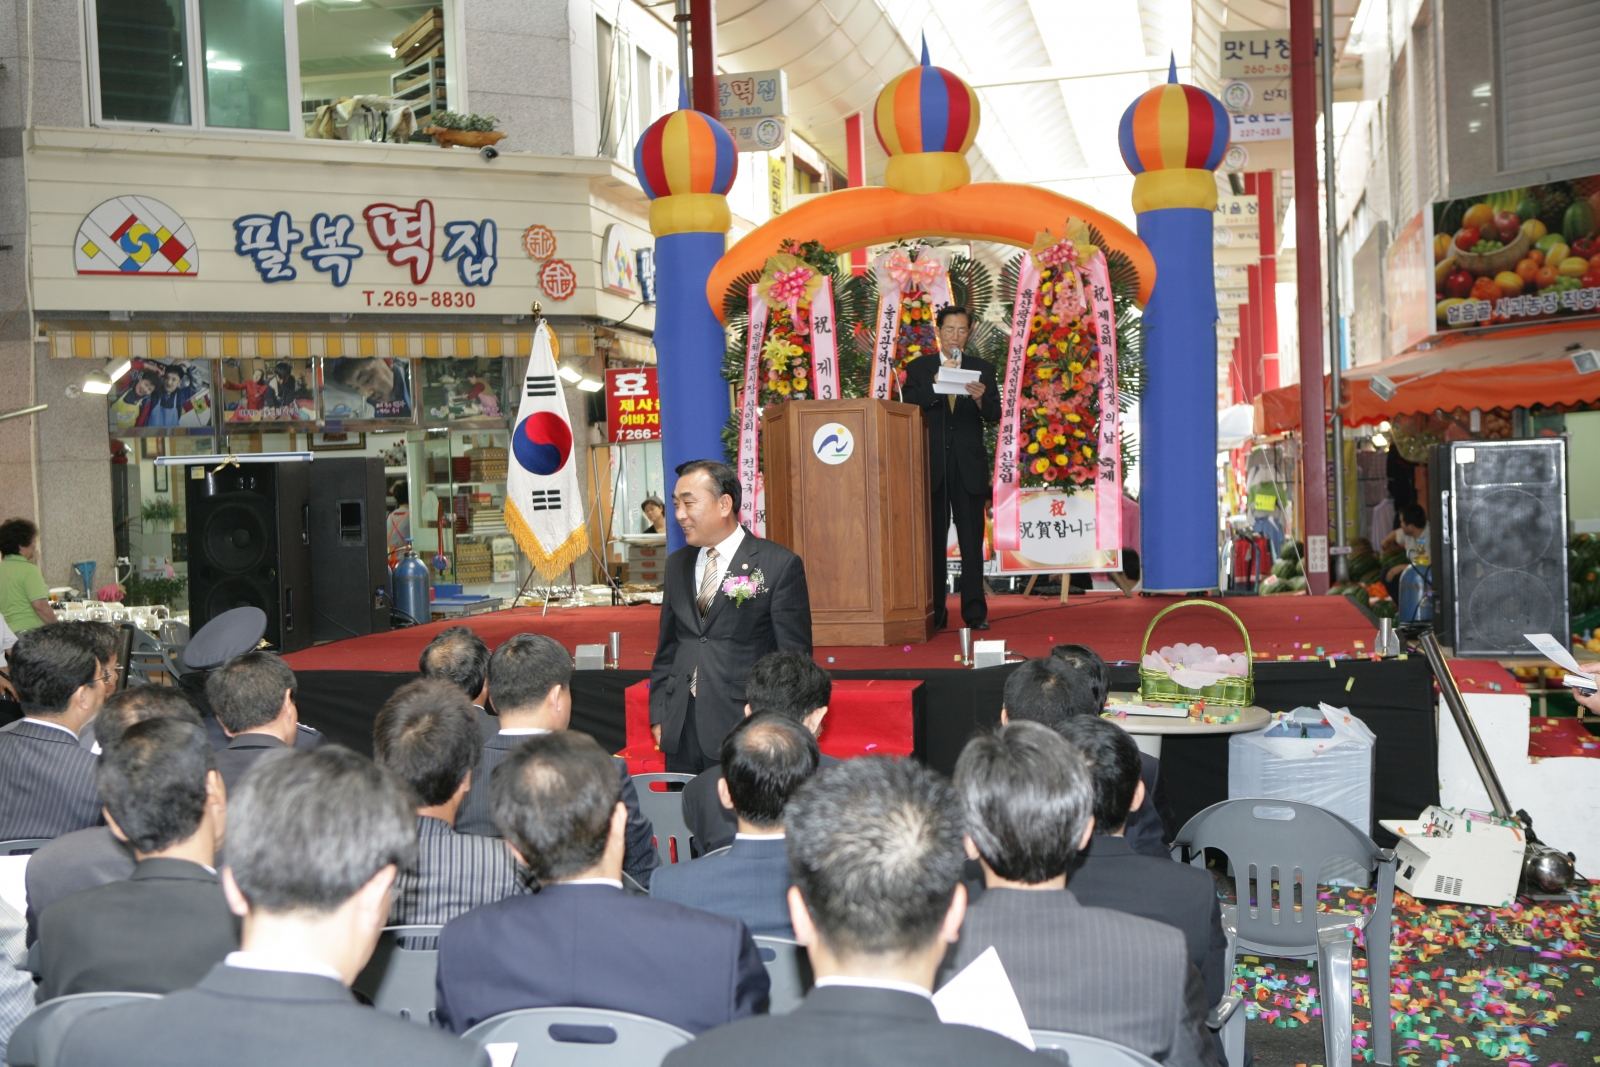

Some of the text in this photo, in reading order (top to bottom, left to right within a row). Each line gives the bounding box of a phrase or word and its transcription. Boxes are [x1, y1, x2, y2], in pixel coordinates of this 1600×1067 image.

[1243, 64, 1289, 75] 260-59
[718, 77, 777, 106] 복떡집
[1262, 88, 1287, 101] 산지
[718, 107, 762, 117] 269-8830
[232, 199, 498, 288] 팔복떡집
[362, 290, 476, 308] T.269-8830
[1093, 285, 1109, 302] 祝
[1447, 301, 1491, 325] 얼음골
[1494, 291, 1559, 318] 사과농장
[814, 315, 832, 335] 祝
[1097, 309, 1112, 347] 제3회
[1001, 423, 1015, 445] 회장
[1049, 498, 1067, 517] 祝
